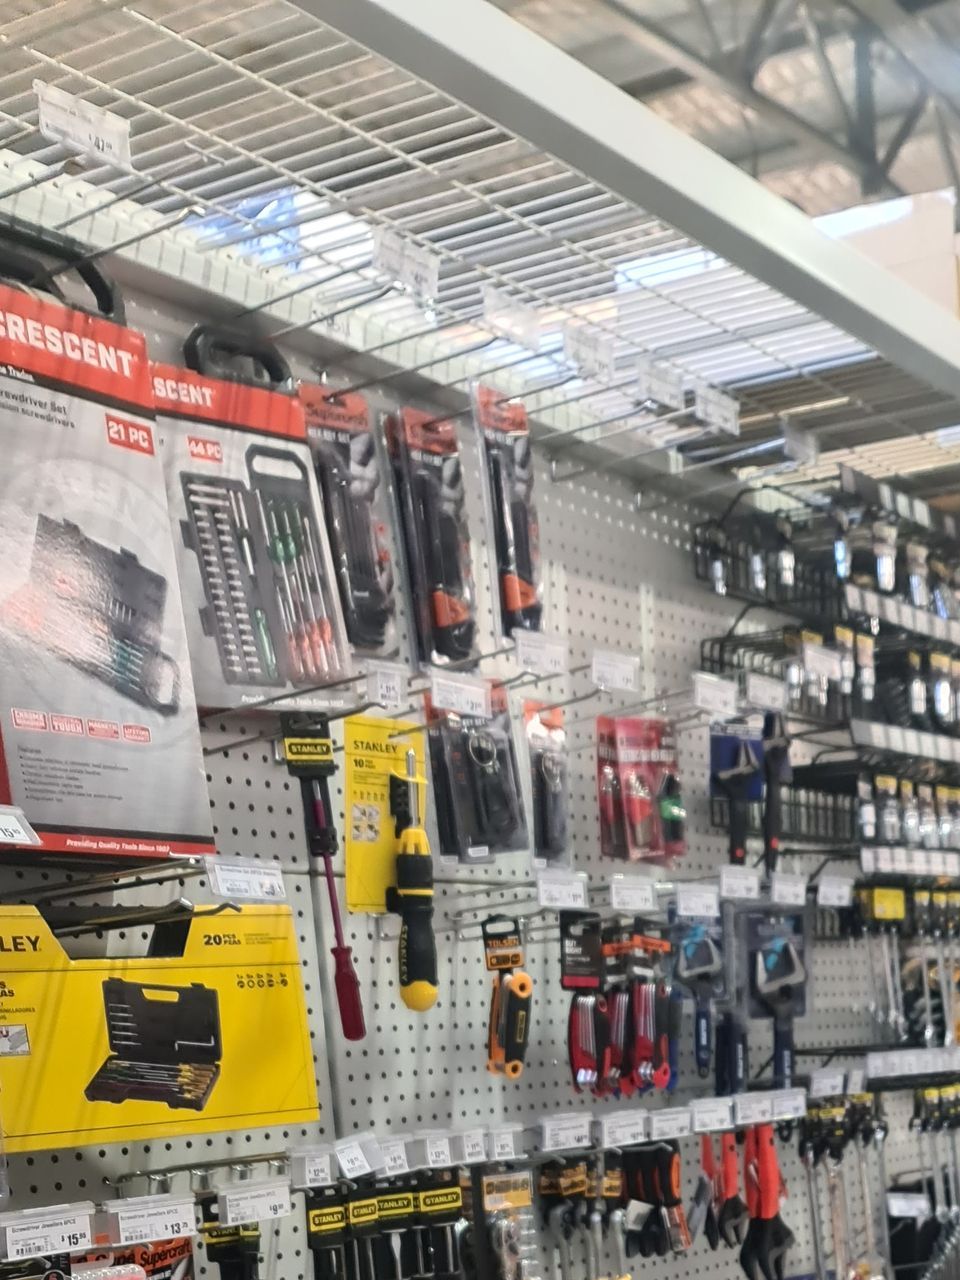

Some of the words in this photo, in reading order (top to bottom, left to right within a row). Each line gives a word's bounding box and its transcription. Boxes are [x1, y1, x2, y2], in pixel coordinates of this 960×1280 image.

[151, 376, 213, 407] SCENT
[108, 421, 126, 441] 21
[129, 426, 150, 450] PC
[204, 442, 222, 459] PC
[291, 743, 328, 754] STANLEY
[353, 739, 398, 754] STANLEY
[203, 934, 222, 946] 20
[424, 1193, 458, 1206] STANLEY
[352, 1205, 376, 1217] STANLEY
[313, 1213, 342, 1225] STANLEY
[61, 1235, 65, 1243] $
[140, 1240, 192, 1268] Supercraft
